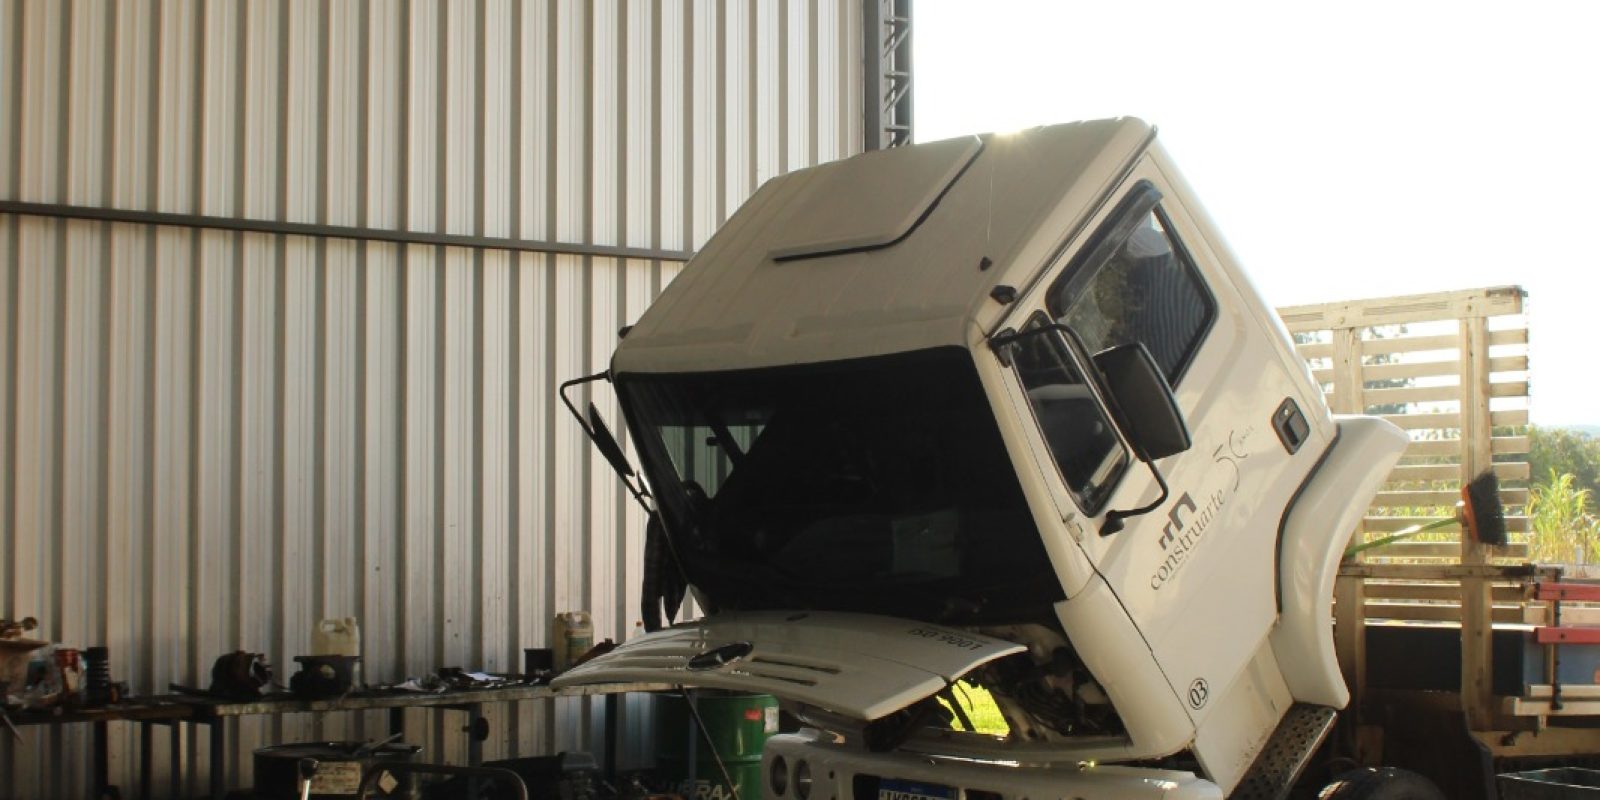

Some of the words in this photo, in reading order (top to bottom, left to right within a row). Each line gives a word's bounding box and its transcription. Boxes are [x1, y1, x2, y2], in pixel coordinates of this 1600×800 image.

[1150, 488, 1224, 591] construarte
[939, 634, 983, 651] 9001
[1190, 680, 1207, 706] 03
